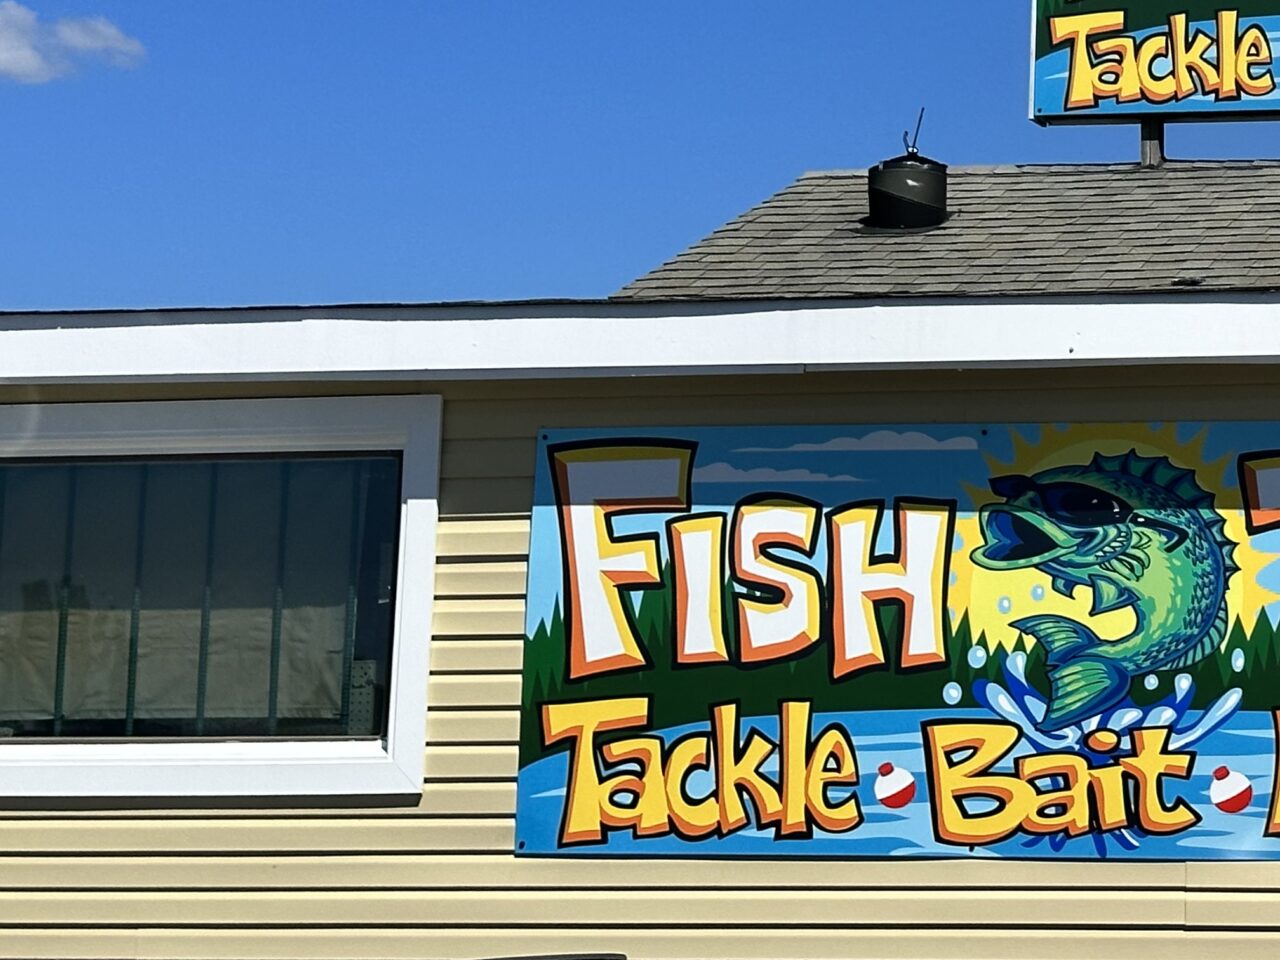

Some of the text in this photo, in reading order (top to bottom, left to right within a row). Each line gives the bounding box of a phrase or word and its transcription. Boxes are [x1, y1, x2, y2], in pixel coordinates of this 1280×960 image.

[1050, 9, 1277, 111] Tackle
[540, 694, 866, 846] Tackle
[921, 719, 1203, 845] Bait
